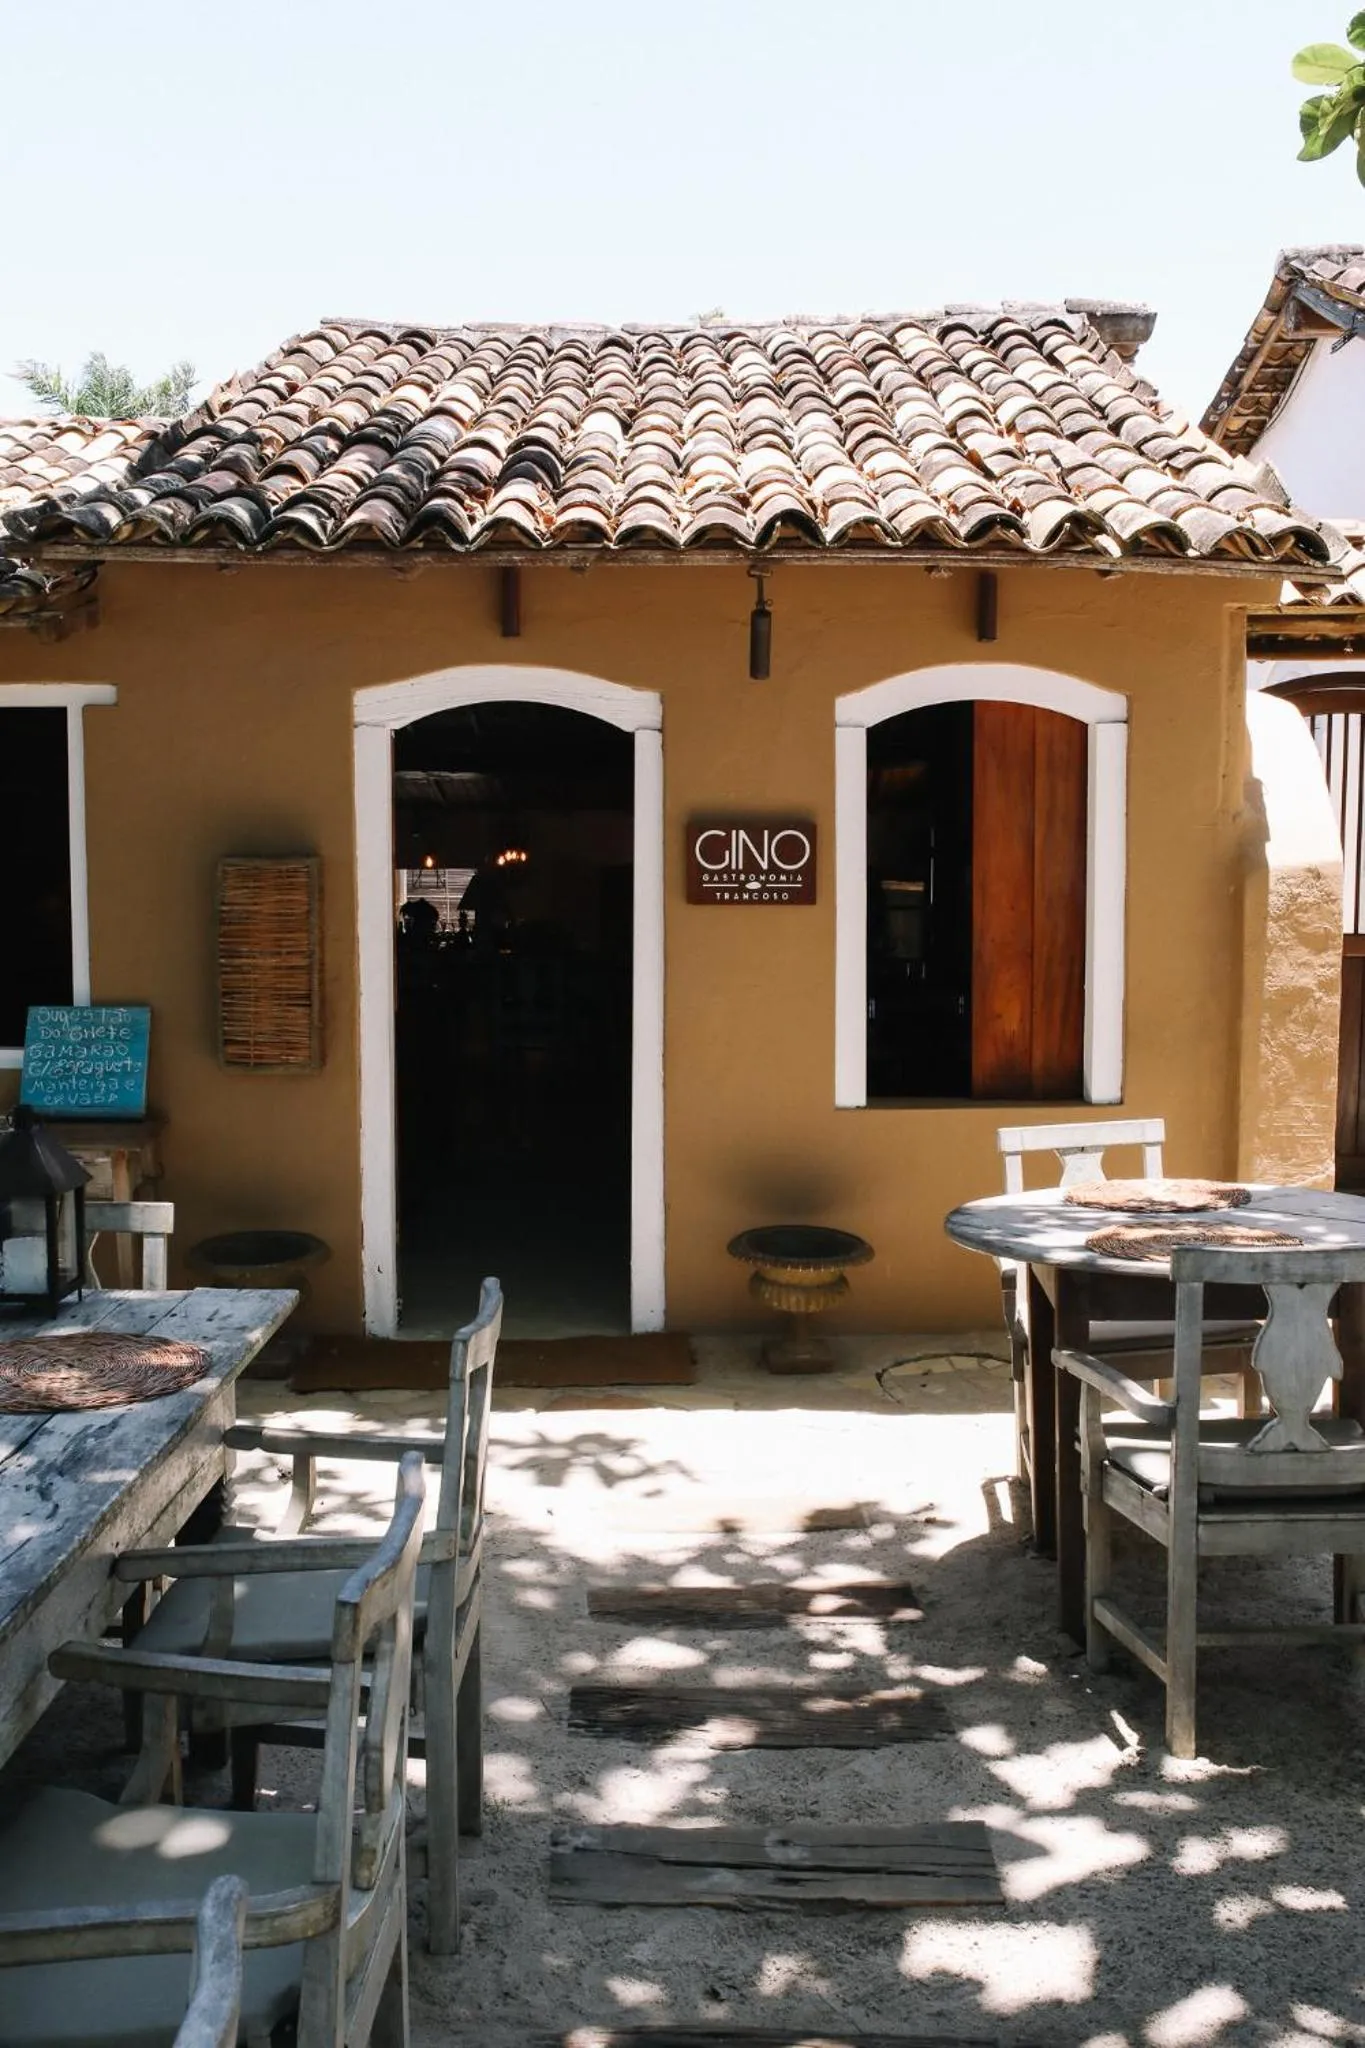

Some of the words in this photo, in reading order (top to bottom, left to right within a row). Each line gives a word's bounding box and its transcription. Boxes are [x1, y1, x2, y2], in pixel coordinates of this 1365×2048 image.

[695, 829, 811, 871] GINO
[702, 873, 803, 882] GASTRONOMIA
[715, 892, 789, 900] TRANCOSO
